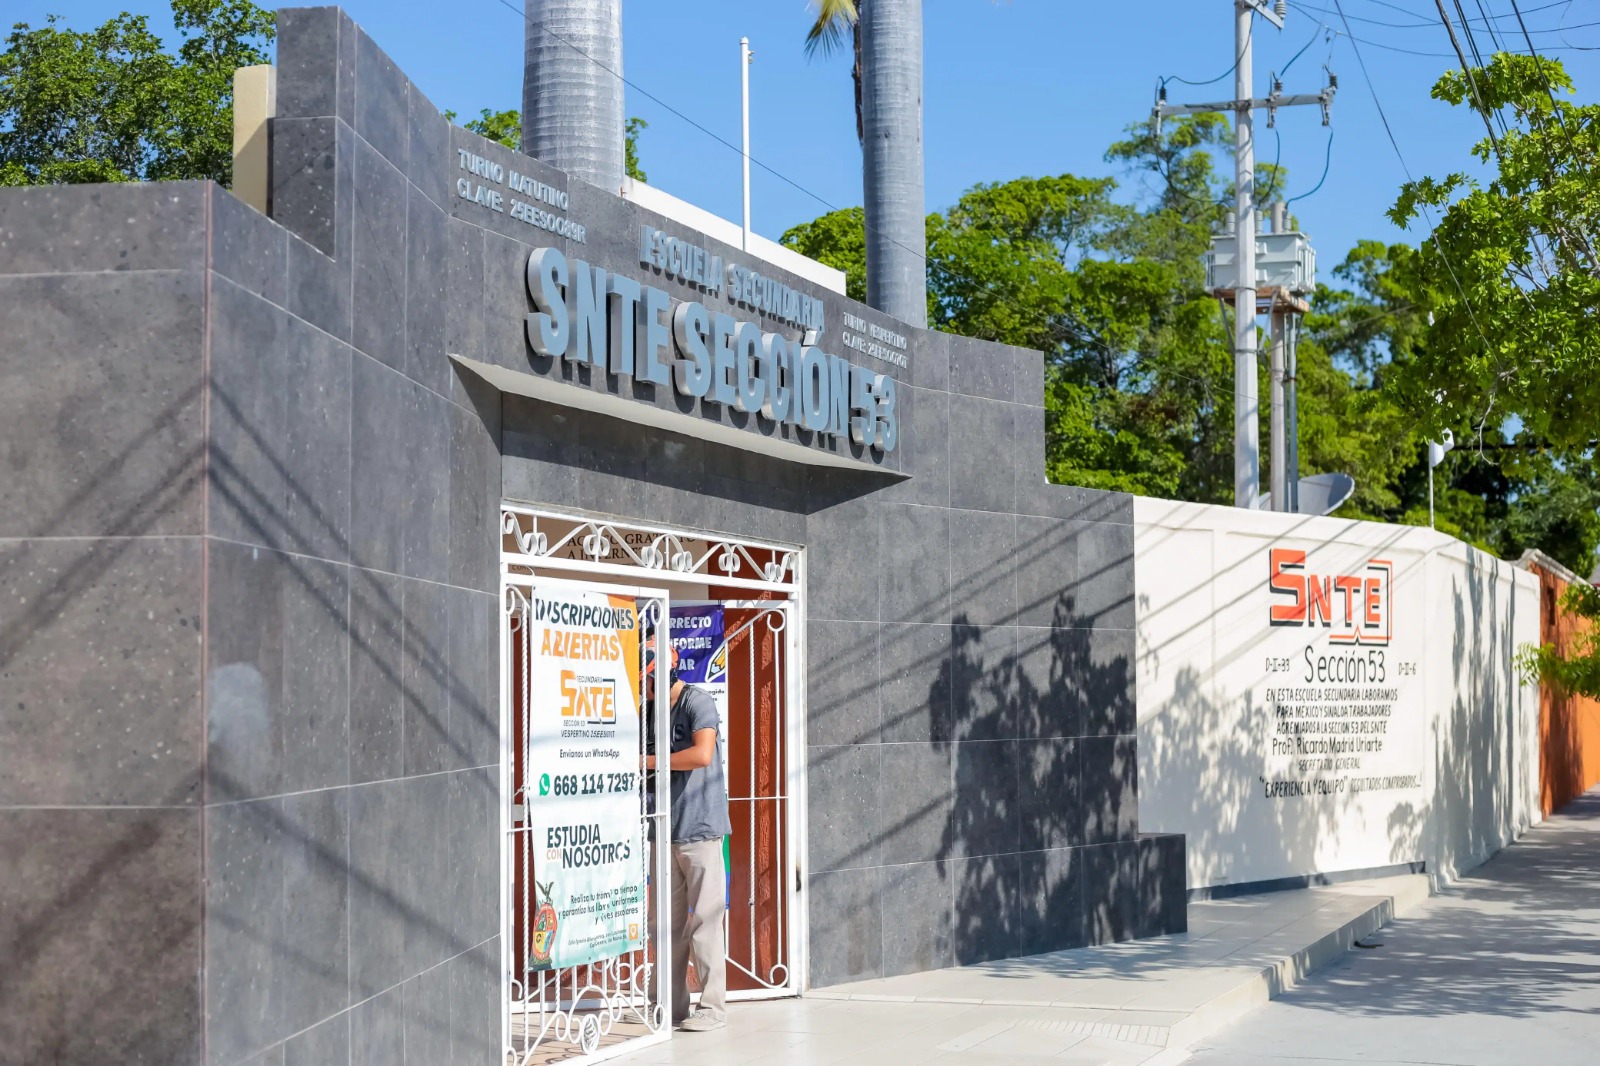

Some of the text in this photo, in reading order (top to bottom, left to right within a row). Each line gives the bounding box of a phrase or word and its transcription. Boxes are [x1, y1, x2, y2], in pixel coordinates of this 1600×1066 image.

[458, 148, 569, 211] TURNO MATUTINO
[640, 225, 825, 333] ESCUELA SECUNDARIA
[527, 247, 897, 451] SNTE SECCIÓN 53
[1269, 548, 1381, 628] SNTE
[535, 598, 634, 630] INSCRIPCIONES
[541, 628, 620, 661] ABIERTAS
[1304, 645, 1386, 683] Sección 53
[1266, 688, 1398, 703] EN ESTA ESCUELA SECUNDARIA LABORAMOS
[1276, 705, 1293, 718] PARA
[1324, 705, 1348, 718] SINALOA
[1349, 704, 1391, 717] TRABAJADORES
[1277, 721, 1316, 734] AGREMIADOS
[592, 748, 620, 759] WhatsApp
[1273, 736, 1383, 755] Prof. Ricardo Madrid Uriarte
[554, 773, 635, 796] 668 114 7297
[547, 824, 601, 848] ESTUDIA
[546, 840, 630, 869] CON NOSOTROS
